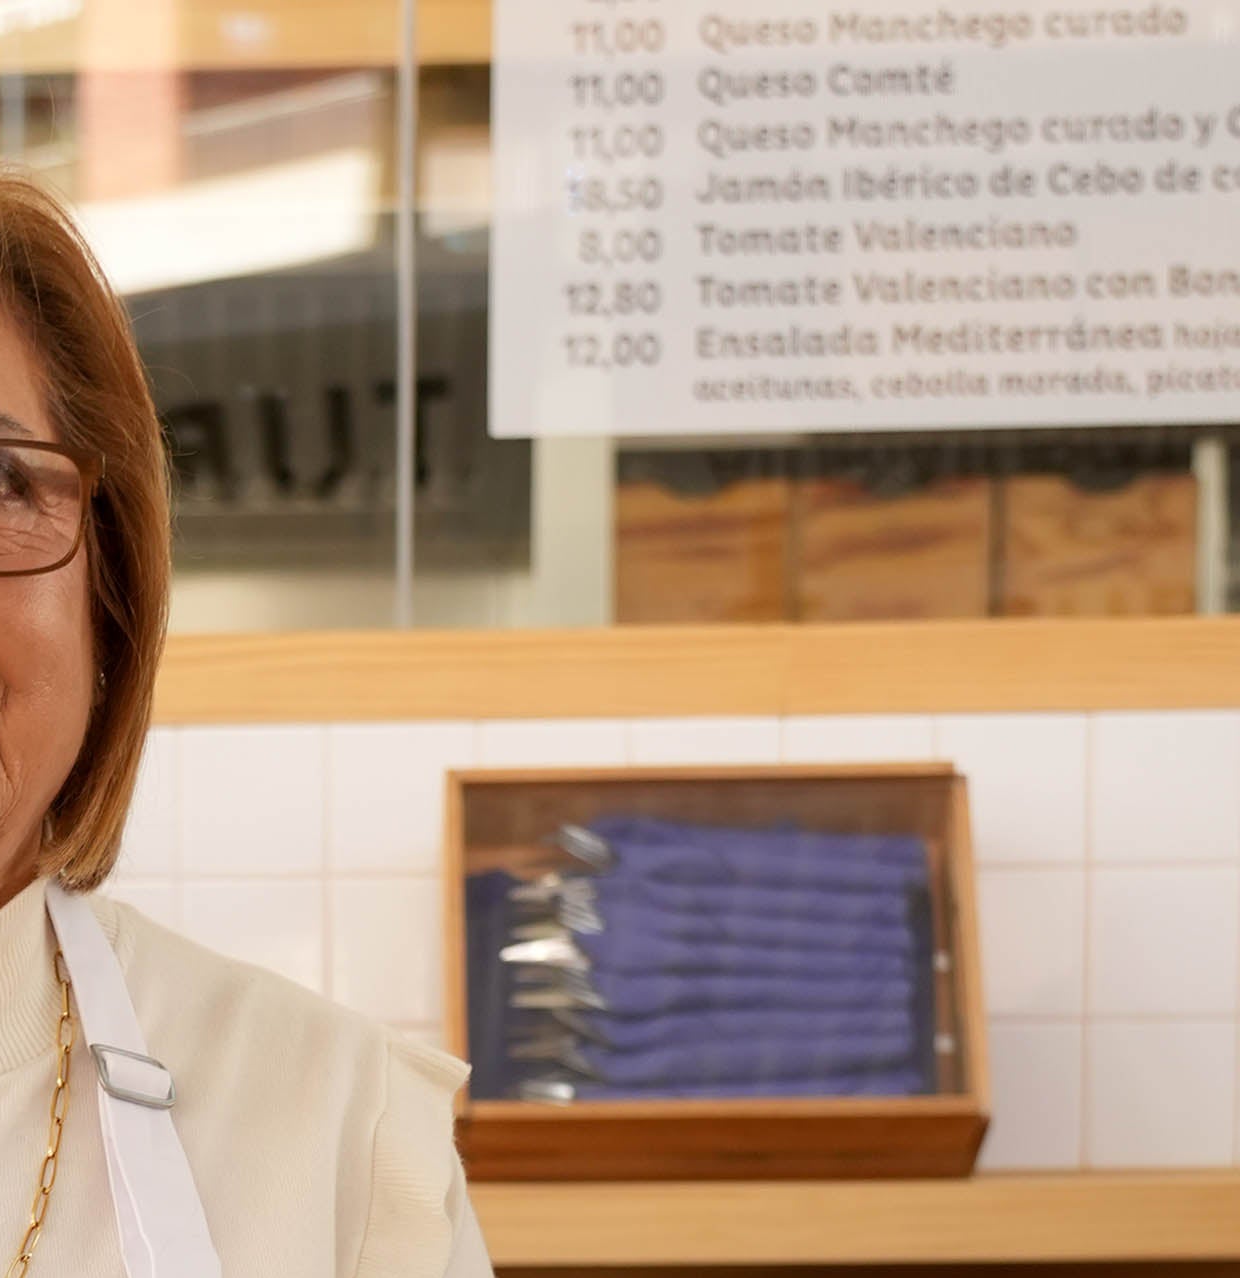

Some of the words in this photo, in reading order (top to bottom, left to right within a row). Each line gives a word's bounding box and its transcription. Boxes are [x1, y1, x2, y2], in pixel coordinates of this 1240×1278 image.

[698, 14, 817, 54] Queso
[828, 8, 1033, 49] Manchego
[1044, 2, 1188, 38] curado
[697, 66, 816, 105] Queso
[826, 58, 956, 97] Comté
[697, 118, 816, 158] Queso
[827, 111, 1030, 154] Manchego
[1041, 104, 1184, 142] curado
[1193, 113, 1217, 148] y
[695, 167, 830, 203] Jamón
[844, 162, 980, 200] Ibérico
[988, 162, 1037, 197] de
[1047, 160, 1144, 196] Cebo
[1154, 156, 1201, 193] de
[695, 223, 844, 256] Tomate
[853, 213, 1079, 250] Valenciano
[695, 274, 843, 307] Tomate
[853, 264, 1076, 303] Valenciano
[1086, 270, 1157, 300] con
[695, 324, 879, 358] Ensalada
[891, 316, 1163, 353] Mediterránea
